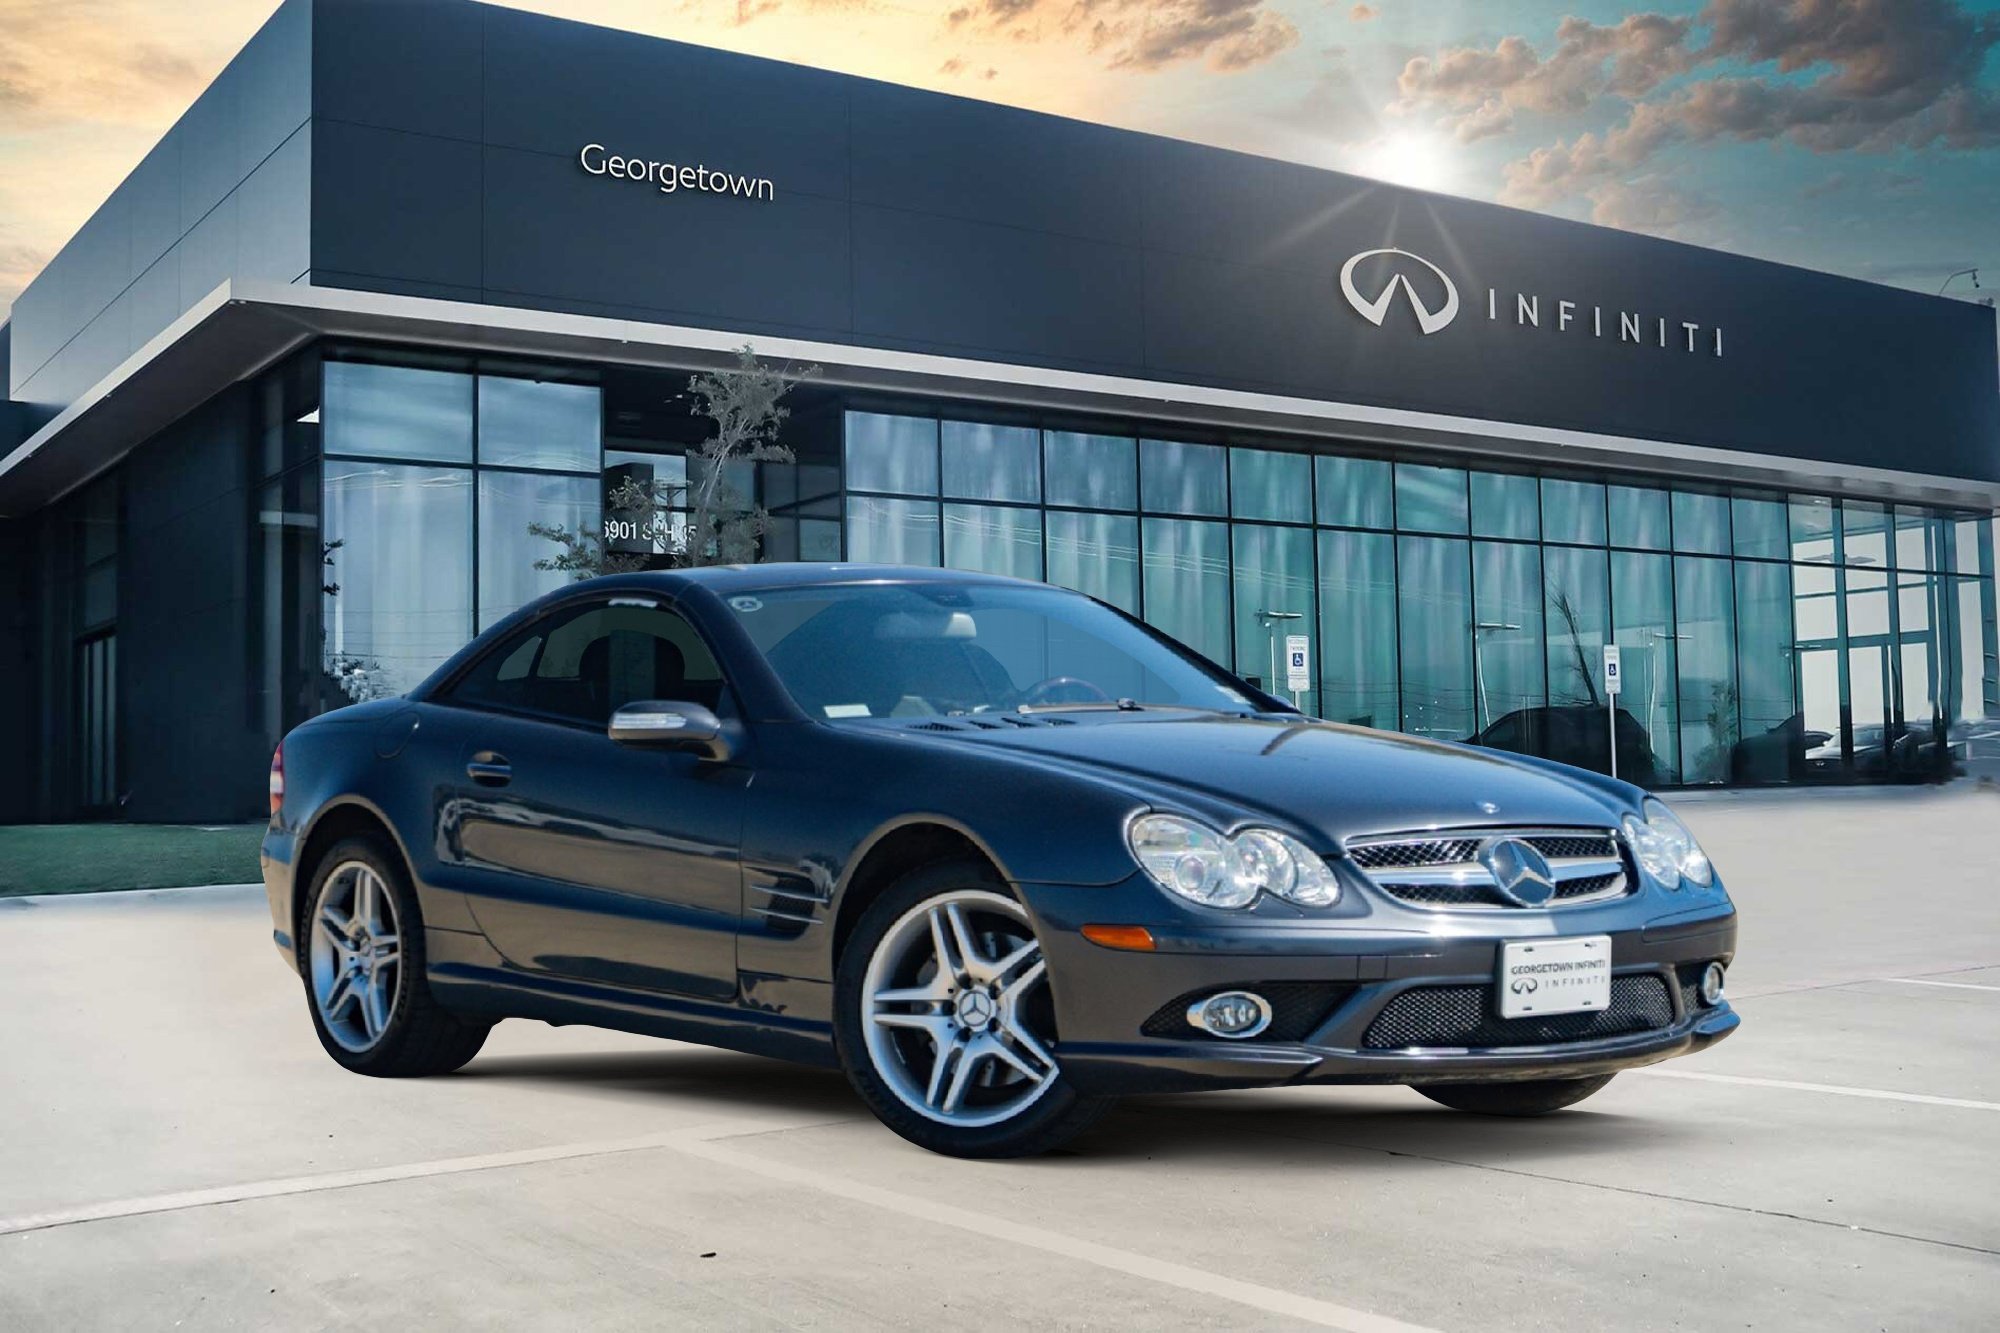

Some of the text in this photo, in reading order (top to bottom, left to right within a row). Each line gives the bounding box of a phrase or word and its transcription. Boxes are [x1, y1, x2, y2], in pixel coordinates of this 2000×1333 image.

[580, 143, 774, 201] Georgetown
[1488, 287, 1723, 357] INFINITI
[1510, 959, 1606, 975] GEORGETOWN INFINITI
[1545, 975, 1606, 989] INFINITI
